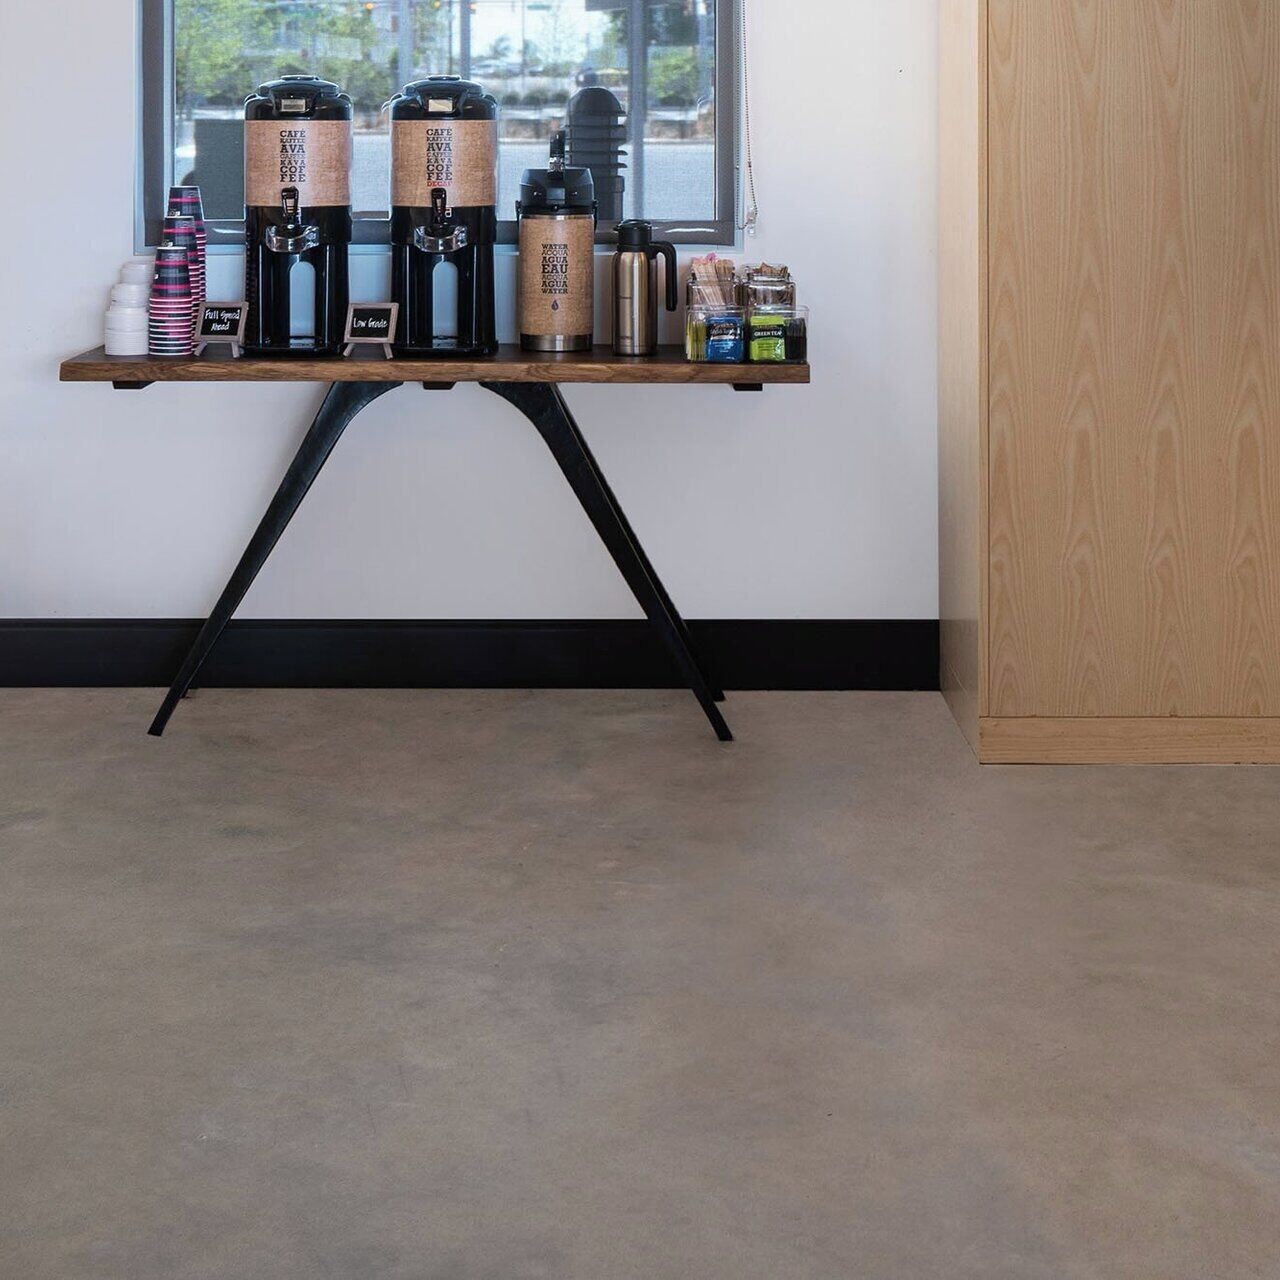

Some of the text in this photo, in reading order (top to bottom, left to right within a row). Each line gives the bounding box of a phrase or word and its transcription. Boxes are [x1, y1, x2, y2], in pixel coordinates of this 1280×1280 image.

[280, 144, 305, 154] AVA
[426, 142, 453, 151] AVA
[426, 164, 453, 172] COF
[280, 174, 305, 182] FEE
[426, 172, 453, 180] FEE
[541, 264, 568, 273] EAU
[204, 309, 240, 322] Full Speed
[211, 321, 230, 331] Ahead
[353, 317, 388, 328] Low Grade
